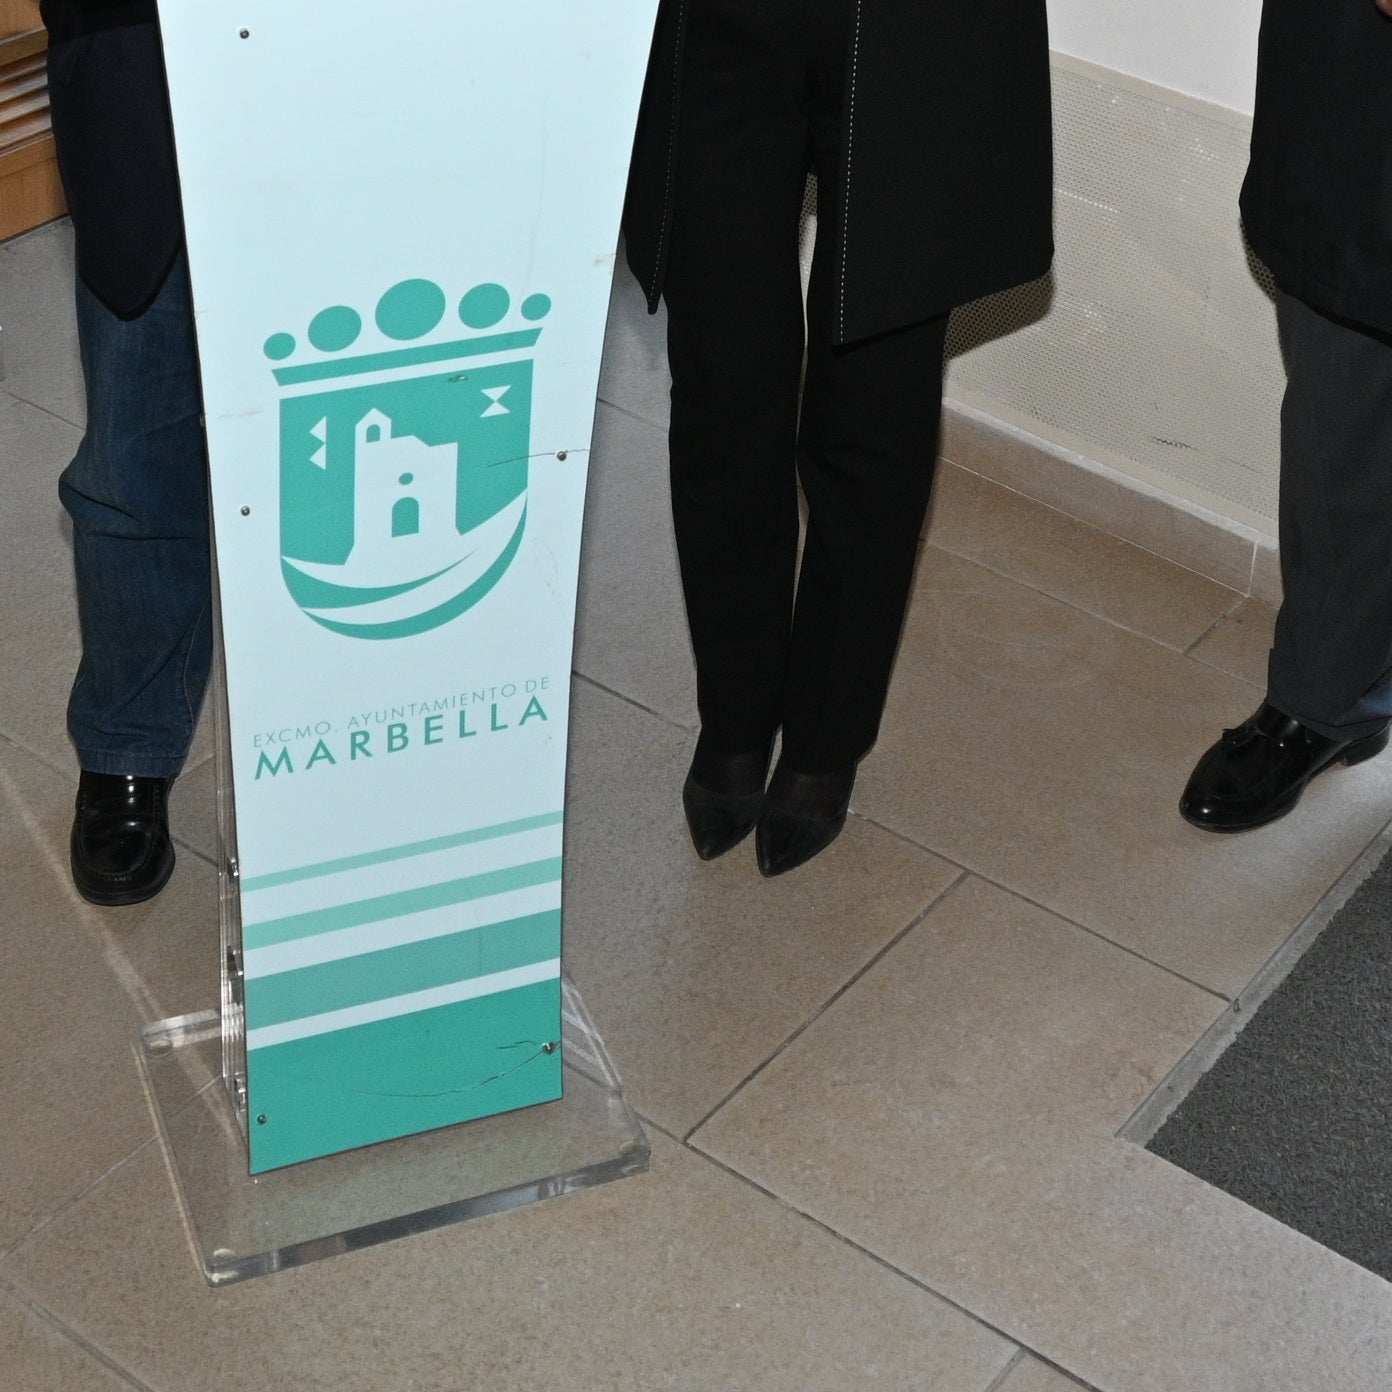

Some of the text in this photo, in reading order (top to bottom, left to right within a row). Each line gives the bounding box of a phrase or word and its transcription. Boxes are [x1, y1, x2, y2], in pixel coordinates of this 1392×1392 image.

[253, 676, 550, 748] EXCMO. AYUNTAMIENTO DE
[254, 695, 549, 781] MARBELLA
